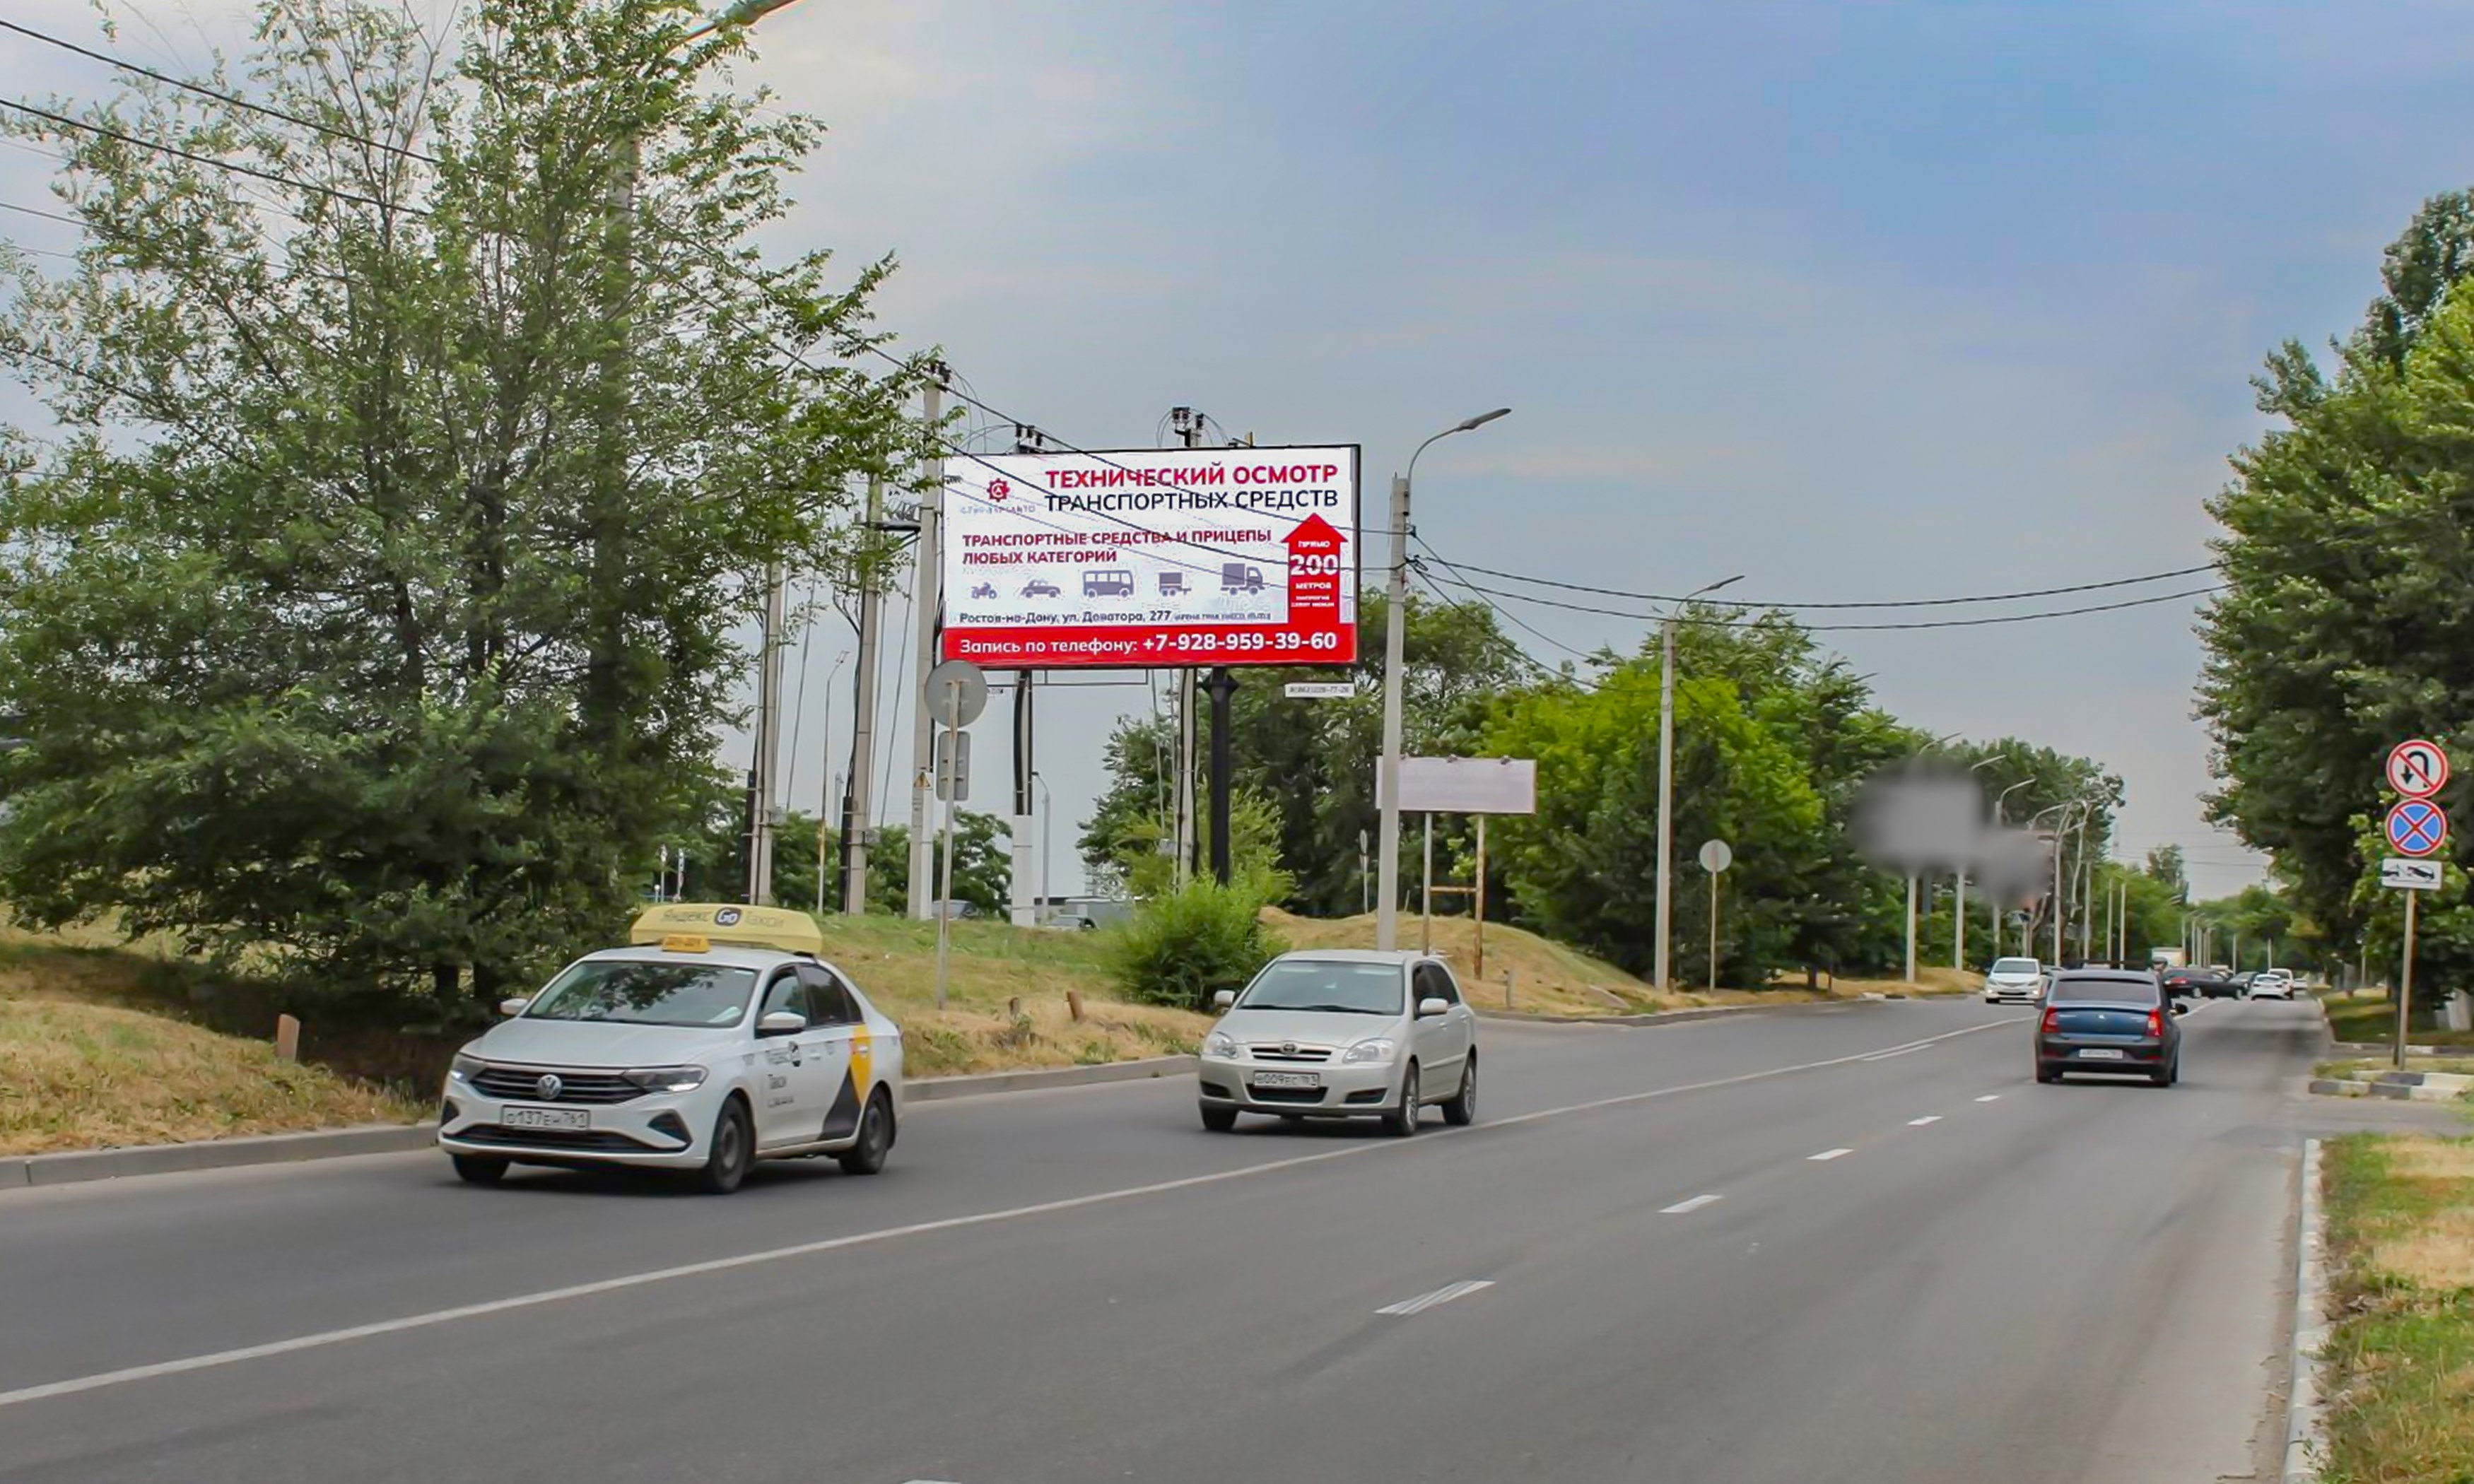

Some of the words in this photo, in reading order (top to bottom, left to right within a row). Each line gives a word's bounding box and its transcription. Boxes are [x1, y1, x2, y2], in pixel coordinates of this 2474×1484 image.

[1045, 461, 1225, 488] ТЕХНИЧЕСКИЙ
[1233, 464, 1339, 484] ОСМОТР
[1045, 491, 1229, 512] ТРАНСПОРТНЫХ
[1235, 489, 1339, 511] СРЕДСТВ
[962, 532, 1087, 547] ТРАНСПОРТНЫЕ
[1091, 530, 1173, 546] СРЕДСТВА
[1176, 531, 1188, 543] И
[1192, 529, 1272, 545] ПРИЦЕПЫ
[962, 551, 1024, 565] ЛЮБЫХ
[1027, 547, 1117, 564] КАТЕГОРИЙ
[1290, 553, 1339, 576] 200
[959, 611, 1060, 625] Ростов-на-Дону,
[1062, 613, 1079, 624] ул.
[1149, 610, 1172, 621] 277
[960, 639, 1021, 654] Запись
[1026, 641, 1046, 653] по
[1050, 637, 1137, 656] телефону:
[1142, 632, 1337, 652] +7-928-959-39-60
